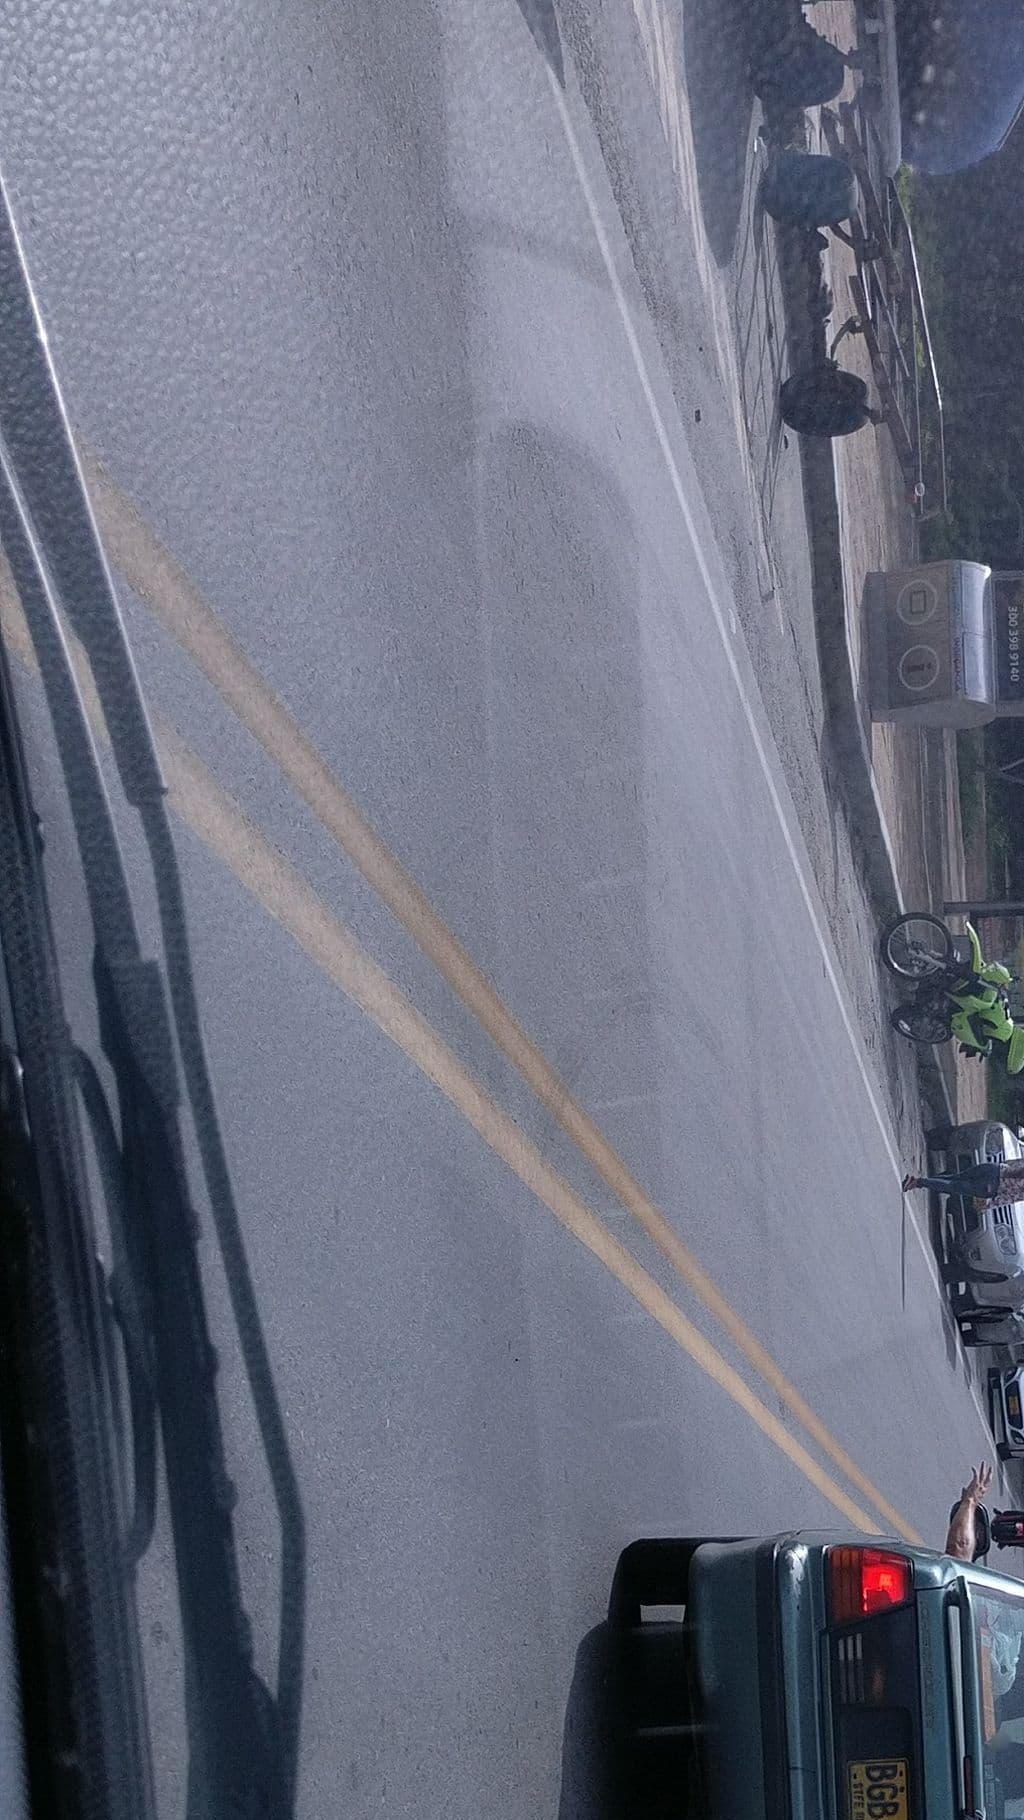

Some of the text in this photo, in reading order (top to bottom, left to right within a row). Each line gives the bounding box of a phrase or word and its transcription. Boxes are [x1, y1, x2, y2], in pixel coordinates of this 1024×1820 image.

[1007, 606, 1020, 682] 300 398 9140
